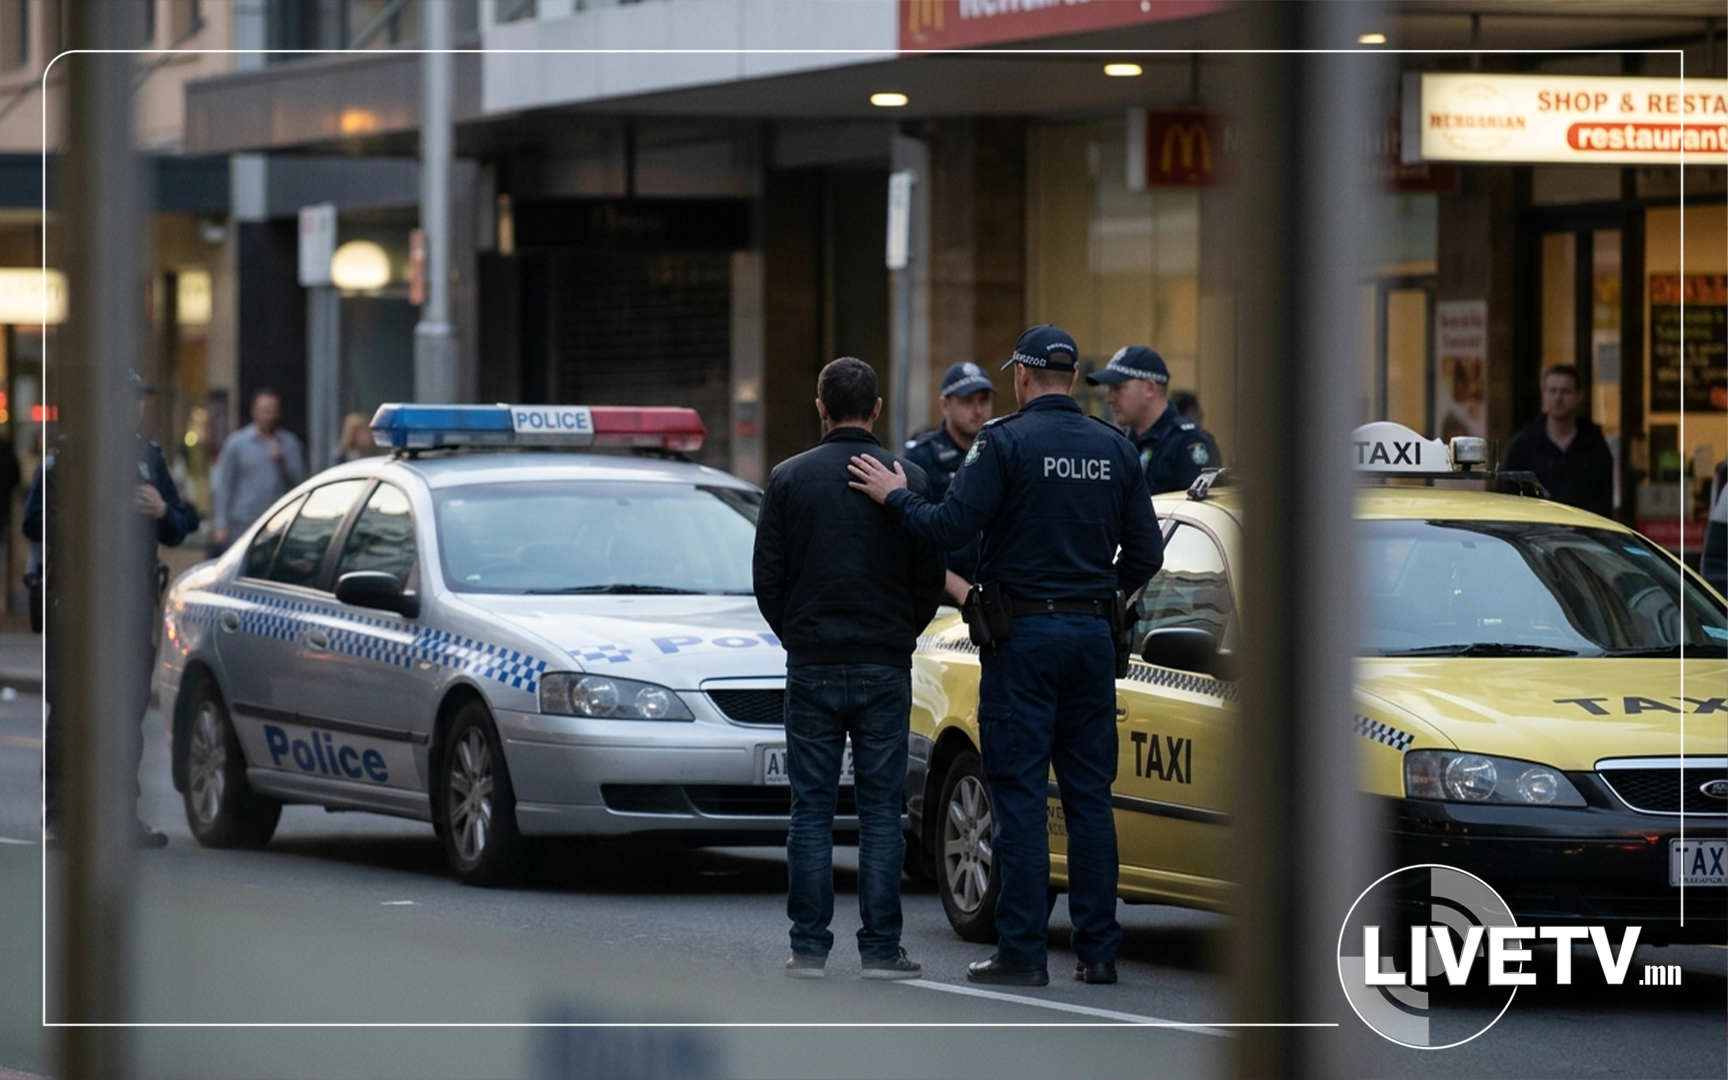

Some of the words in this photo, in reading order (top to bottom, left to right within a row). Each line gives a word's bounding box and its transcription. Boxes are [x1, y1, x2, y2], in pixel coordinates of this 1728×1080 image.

[1538, 91, 1608, 112] SHOP
[1619, 94, 1635, 113] &
[1648, 94, 1728, 114] RESTA
[1577, 125, 1728, 150] restaurant
[515, 411, 588, 430] POLICE
[1353, 441, 1421, 465] TAXI
[1043, 456, 1111, 481] POLICE
[650, 633, 782, 654] Pol
[263, 723, 389, 783] Police
[1130, 730, 1192, 785] TAXI
